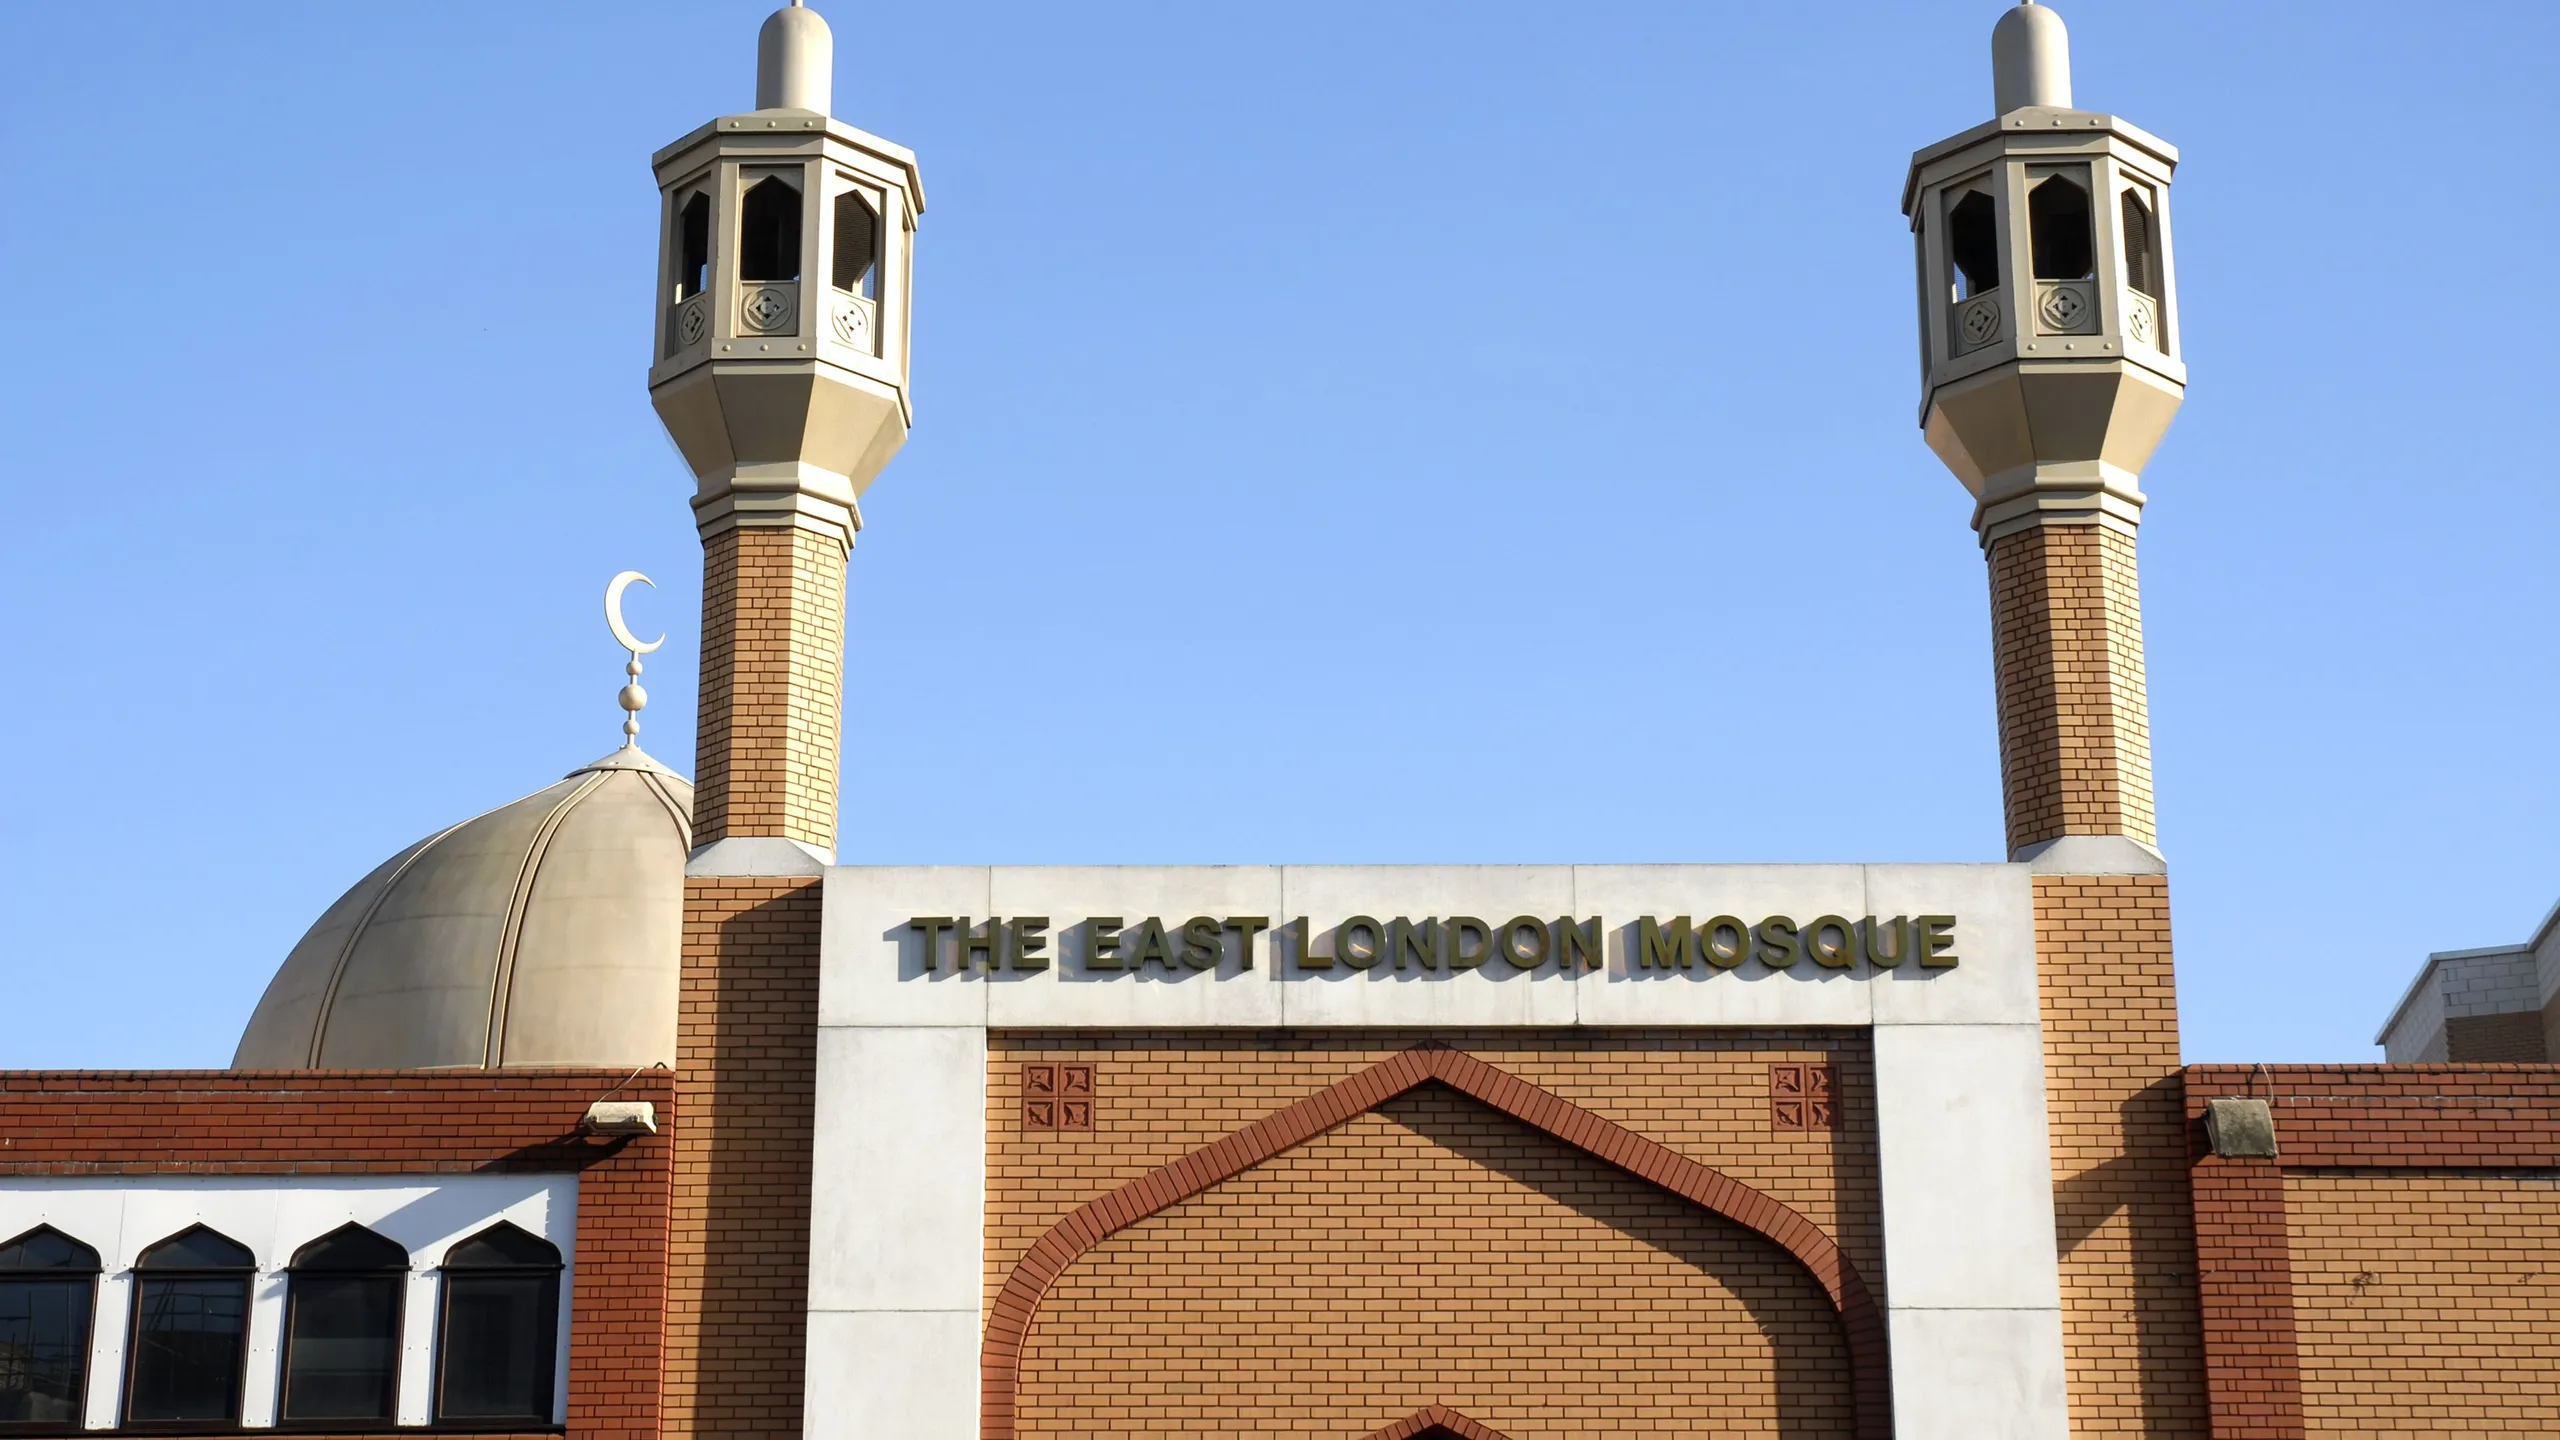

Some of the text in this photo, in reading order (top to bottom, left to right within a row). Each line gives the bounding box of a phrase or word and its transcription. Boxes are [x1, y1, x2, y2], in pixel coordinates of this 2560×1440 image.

[911, 914, 1959, 971] THE EAST LONDON MOSQUE
